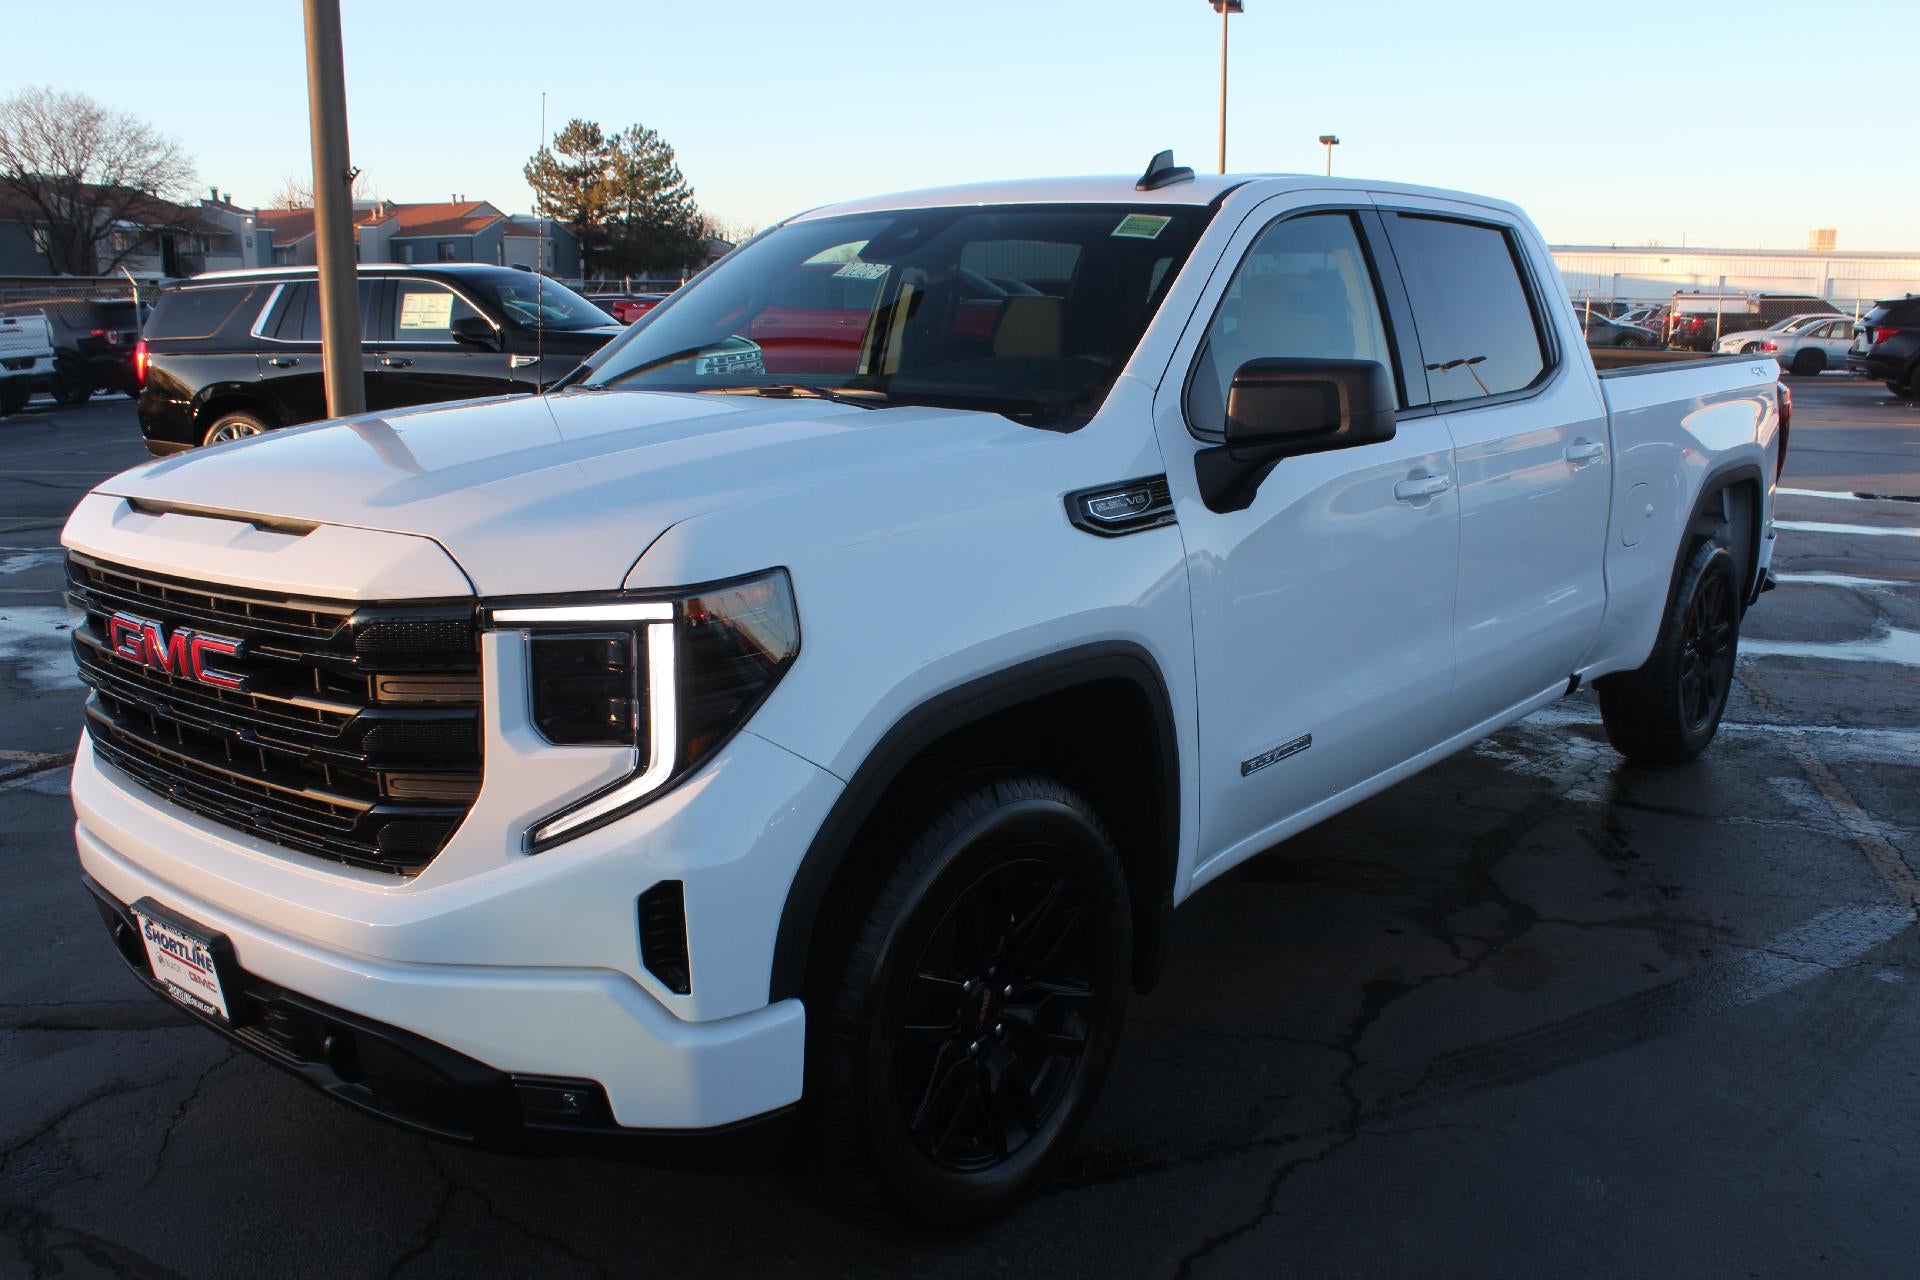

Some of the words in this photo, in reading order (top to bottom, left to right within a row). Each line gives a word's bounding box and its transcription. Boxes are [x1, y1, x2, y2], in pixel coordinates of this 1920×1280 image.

[110, 610, 247, 691] GMC
[144, 923, 214, 974] SHORTLINE
[188, 971, 218, 994] GMC
